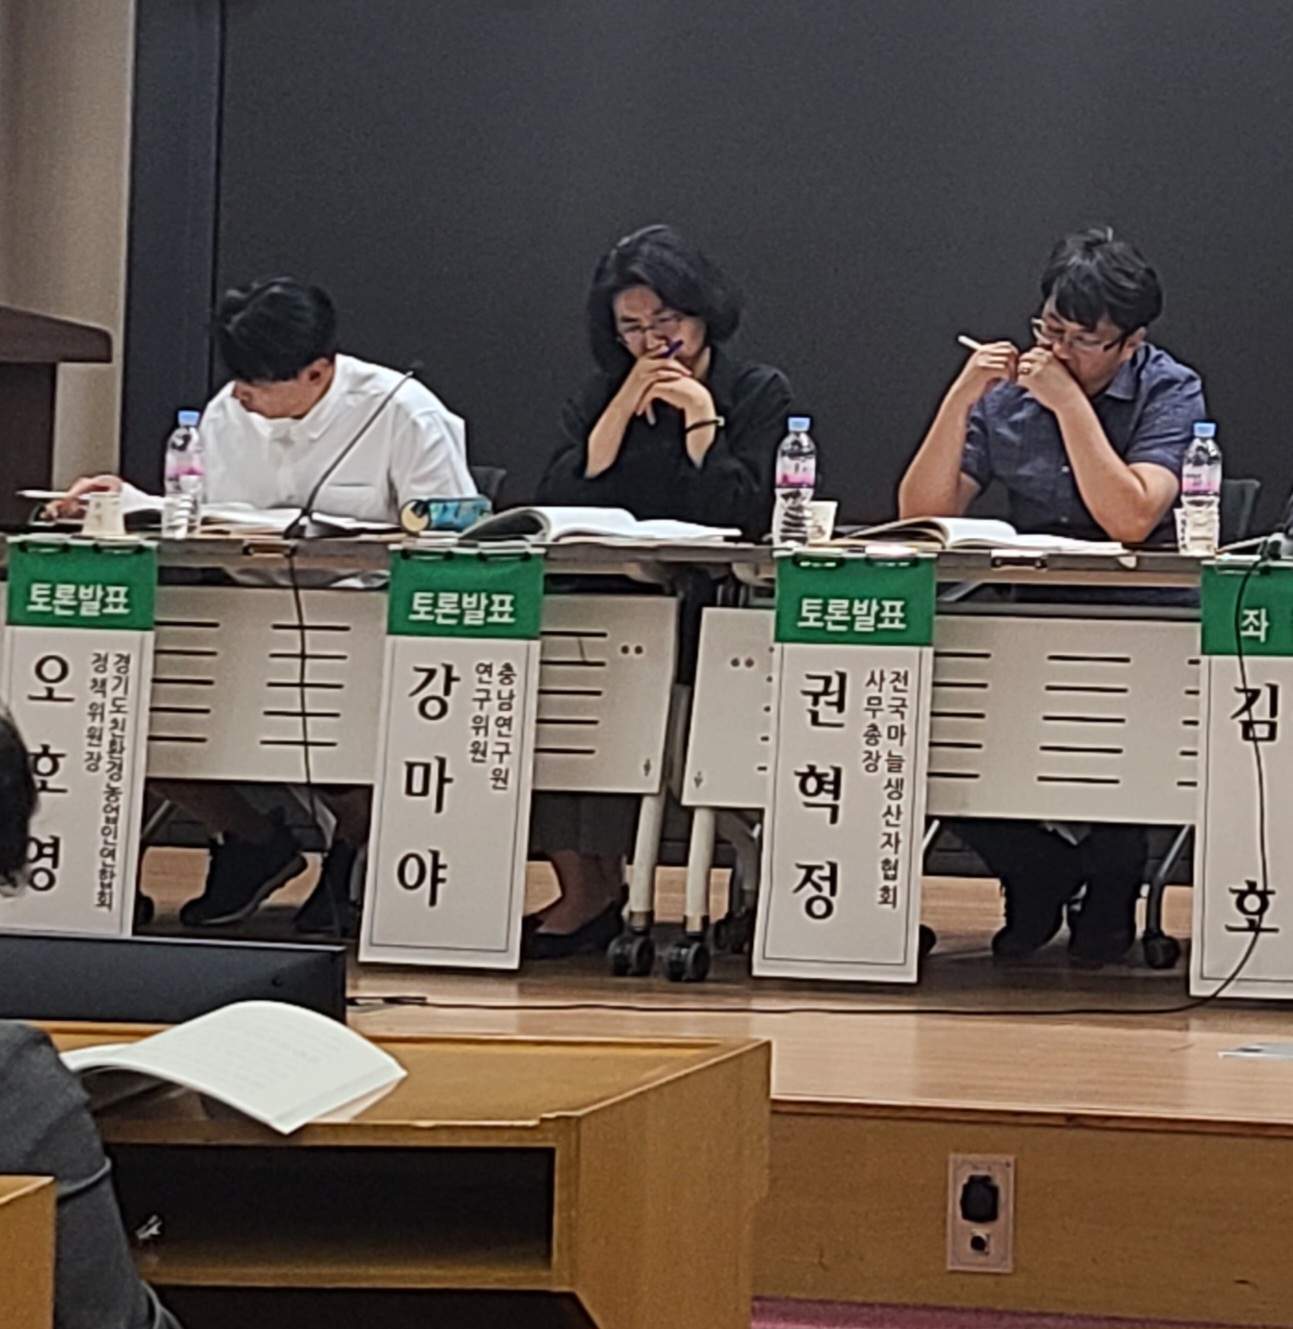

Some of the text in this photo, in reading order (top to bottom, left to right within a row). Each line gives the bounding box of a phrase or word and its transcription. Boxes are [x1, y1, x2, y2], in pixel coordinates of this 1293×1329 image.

[27, 583, 131, 616] 토론발표
[409, 592, 516, 625] 토론발표
[797, 598, 907, 632] 토론발표
[469, 661, 494, 764] 연구위원
[490, 662, 517, 792] 충남연구원
[862, 669, 887, 773] 사무총장
[877, 669, 909, 910] 전국마늘생산자협회
